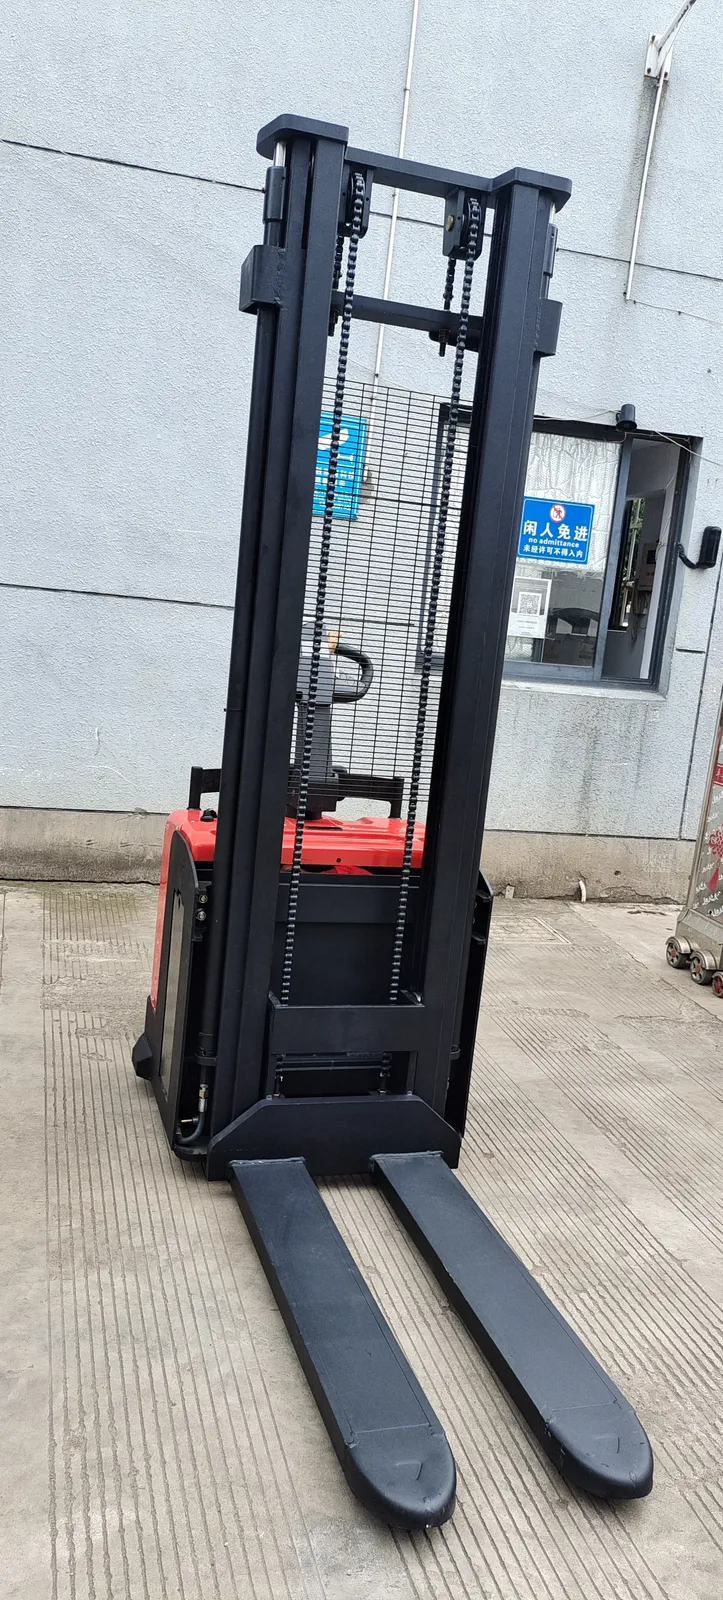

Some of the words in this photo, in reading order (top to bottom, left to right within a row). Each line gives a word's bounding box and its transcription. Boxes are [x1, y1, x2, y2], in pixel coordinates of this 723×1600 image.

[523, 520, 588, 541] 闲人免进
[539, 538, 580, 548] admittance
[523, 544, 583, 558] 未经许可不得入内
